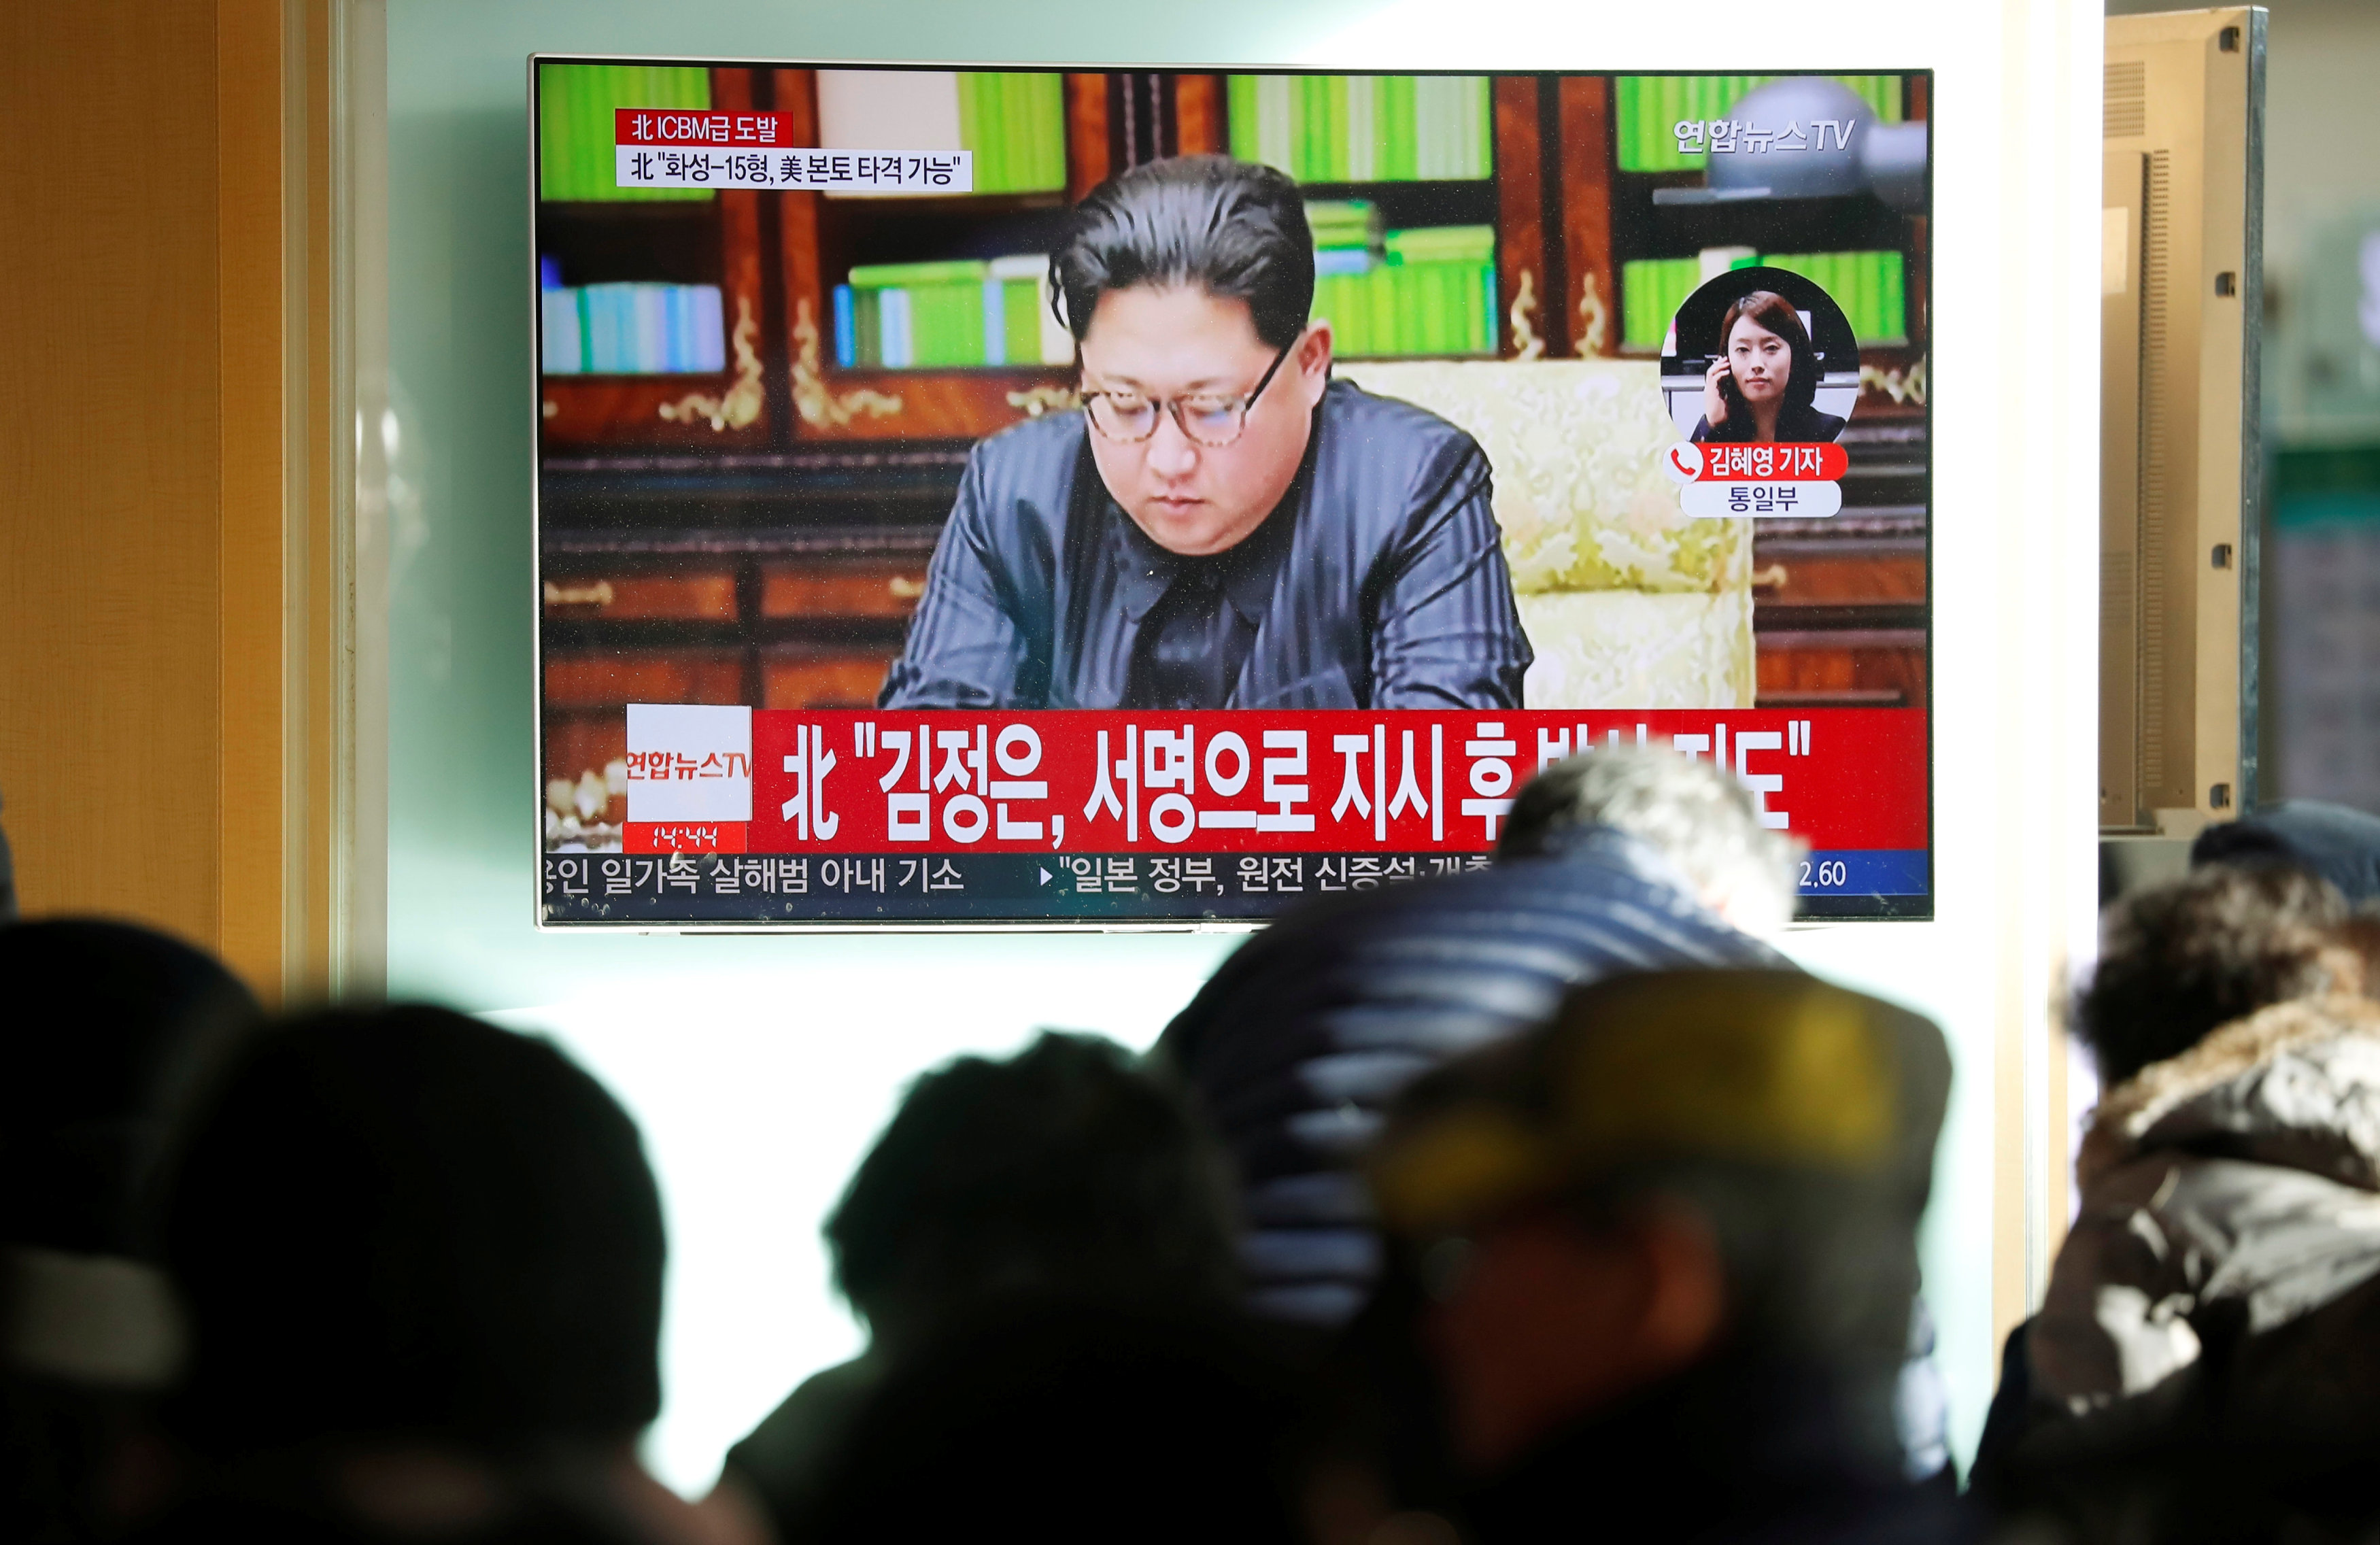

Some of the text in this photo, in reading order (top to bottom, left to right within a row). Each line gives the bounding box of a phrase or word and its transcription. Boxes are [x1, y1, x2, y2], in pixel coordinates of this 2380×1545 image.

[632, 114, 778, 143] 北 ICBM급 도발
[1673, 119, 1855, 154] 연합뉴스TV
[631, 152, 961, 186] 北 "화성-15형, 美 본토 타격 가능"
[1709, 446, 1823, 477] 김혜영 기자
[1728, 486, 1799, 513] 통일부
[626, 751, 751, 780] 연합뉴스TV
[781, 724, 839, 841] 北
[854, 721, 1064, 849] "김정은,
[1083, 724, 1315, 843] 서명으로
[1331, 724, 1443, 842] 지시
[1461, 721, 1516, 841] 후
[653, 826, 717, 849] 14:44
[601, 859, 700, 894] 일가족
[709, 859, 809, 894] 살해범
[821, 858, 885, 893] 아내
[898, 858, 964, 893] 기소
[1059, 857, 1138, 893] "일본
[1149, 858, 1224, 896] 정부,
[1236, 857, 1304, 893] 원전
